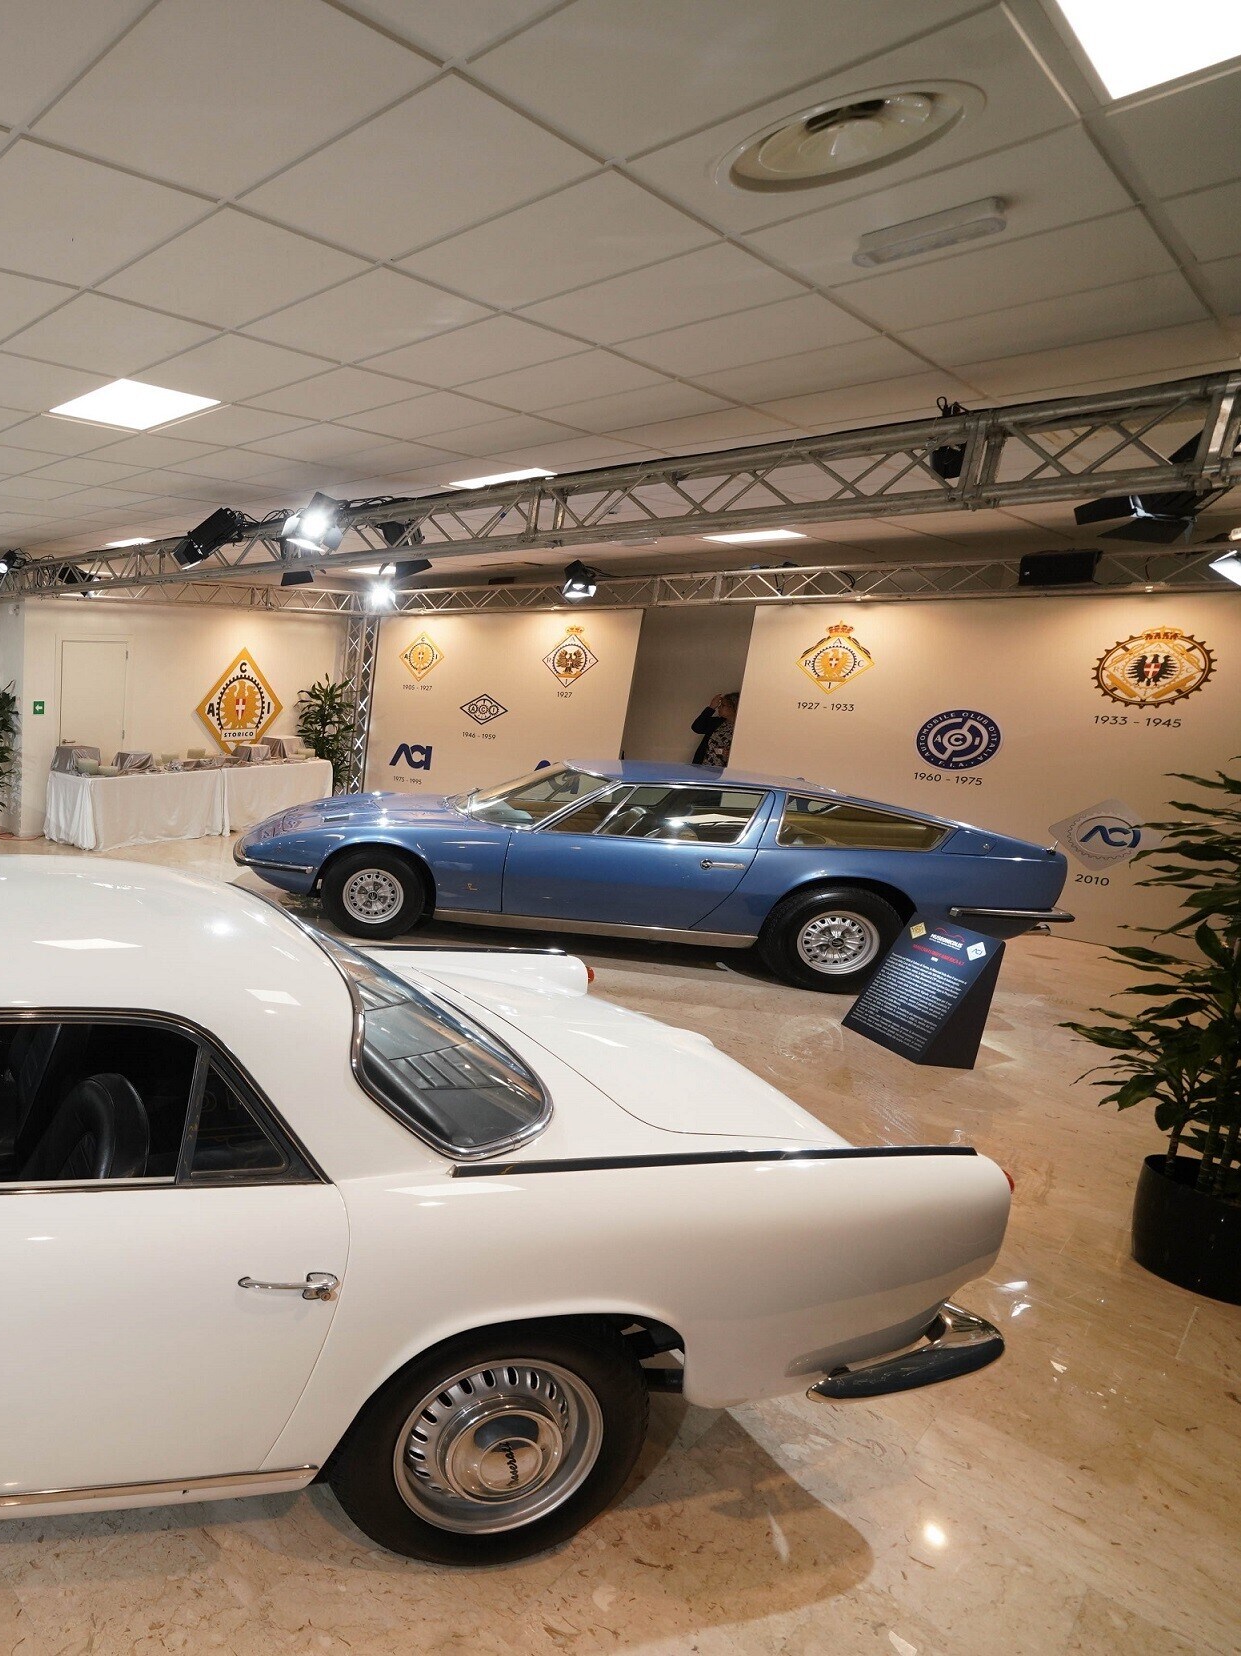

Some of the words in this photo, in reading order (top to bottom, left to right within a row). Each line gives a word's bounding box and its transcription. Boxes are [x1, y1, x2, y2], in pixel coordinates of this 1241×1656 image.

[239, 661, 248, 674] C
[206, 702, 216, 717] A
[797, 701, 820, 710] 1927
[831, 703, 855, 712] 1933
[1093, 715, 1128, 726] 1933
[1145, 717, 1182, 728] 1945
[462, 731, 476, 739] 1946
[388, 743, 433, 771] ACI
[913, 772, 942, 782] 1960
[954, 775, 983, 786] 1975
[1080, 825, 1141, 849] ACI
[1075, 873, 1110, 886] 2010
